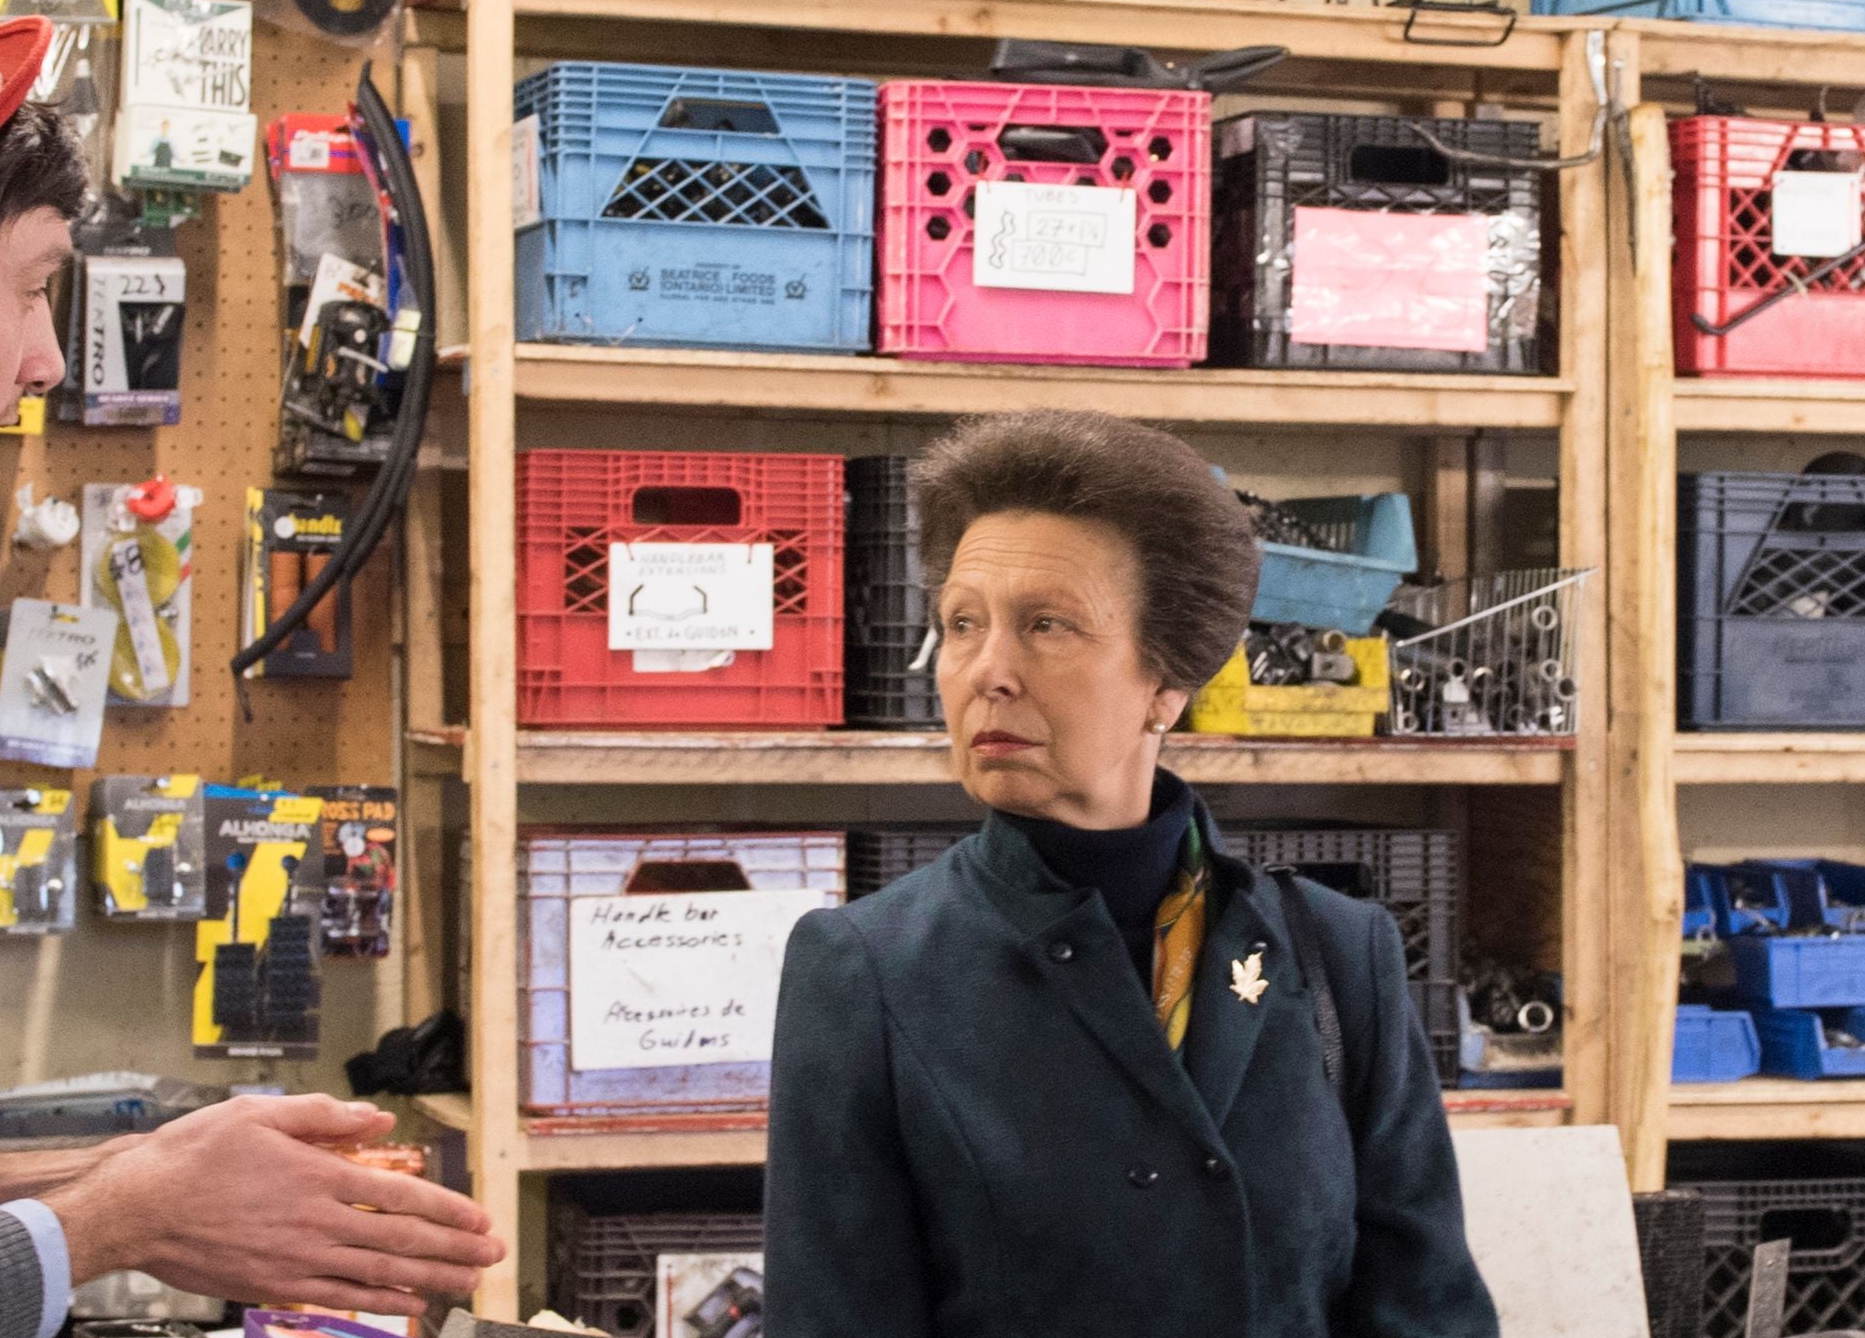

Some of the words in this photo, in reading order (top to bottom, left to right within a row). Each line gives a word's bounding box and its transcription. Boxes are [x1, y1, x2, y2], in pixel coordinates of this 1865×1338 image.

[199, 61, 247, 107] THIS
[660, 268, 720, 281] BEATRICE
[731, 272, 776, 285] FOODS
[726, 283, 776, 297] LIMITED
[220, 819, 311, 839] ALHONGA
[721, 999, 746, 1018] de
